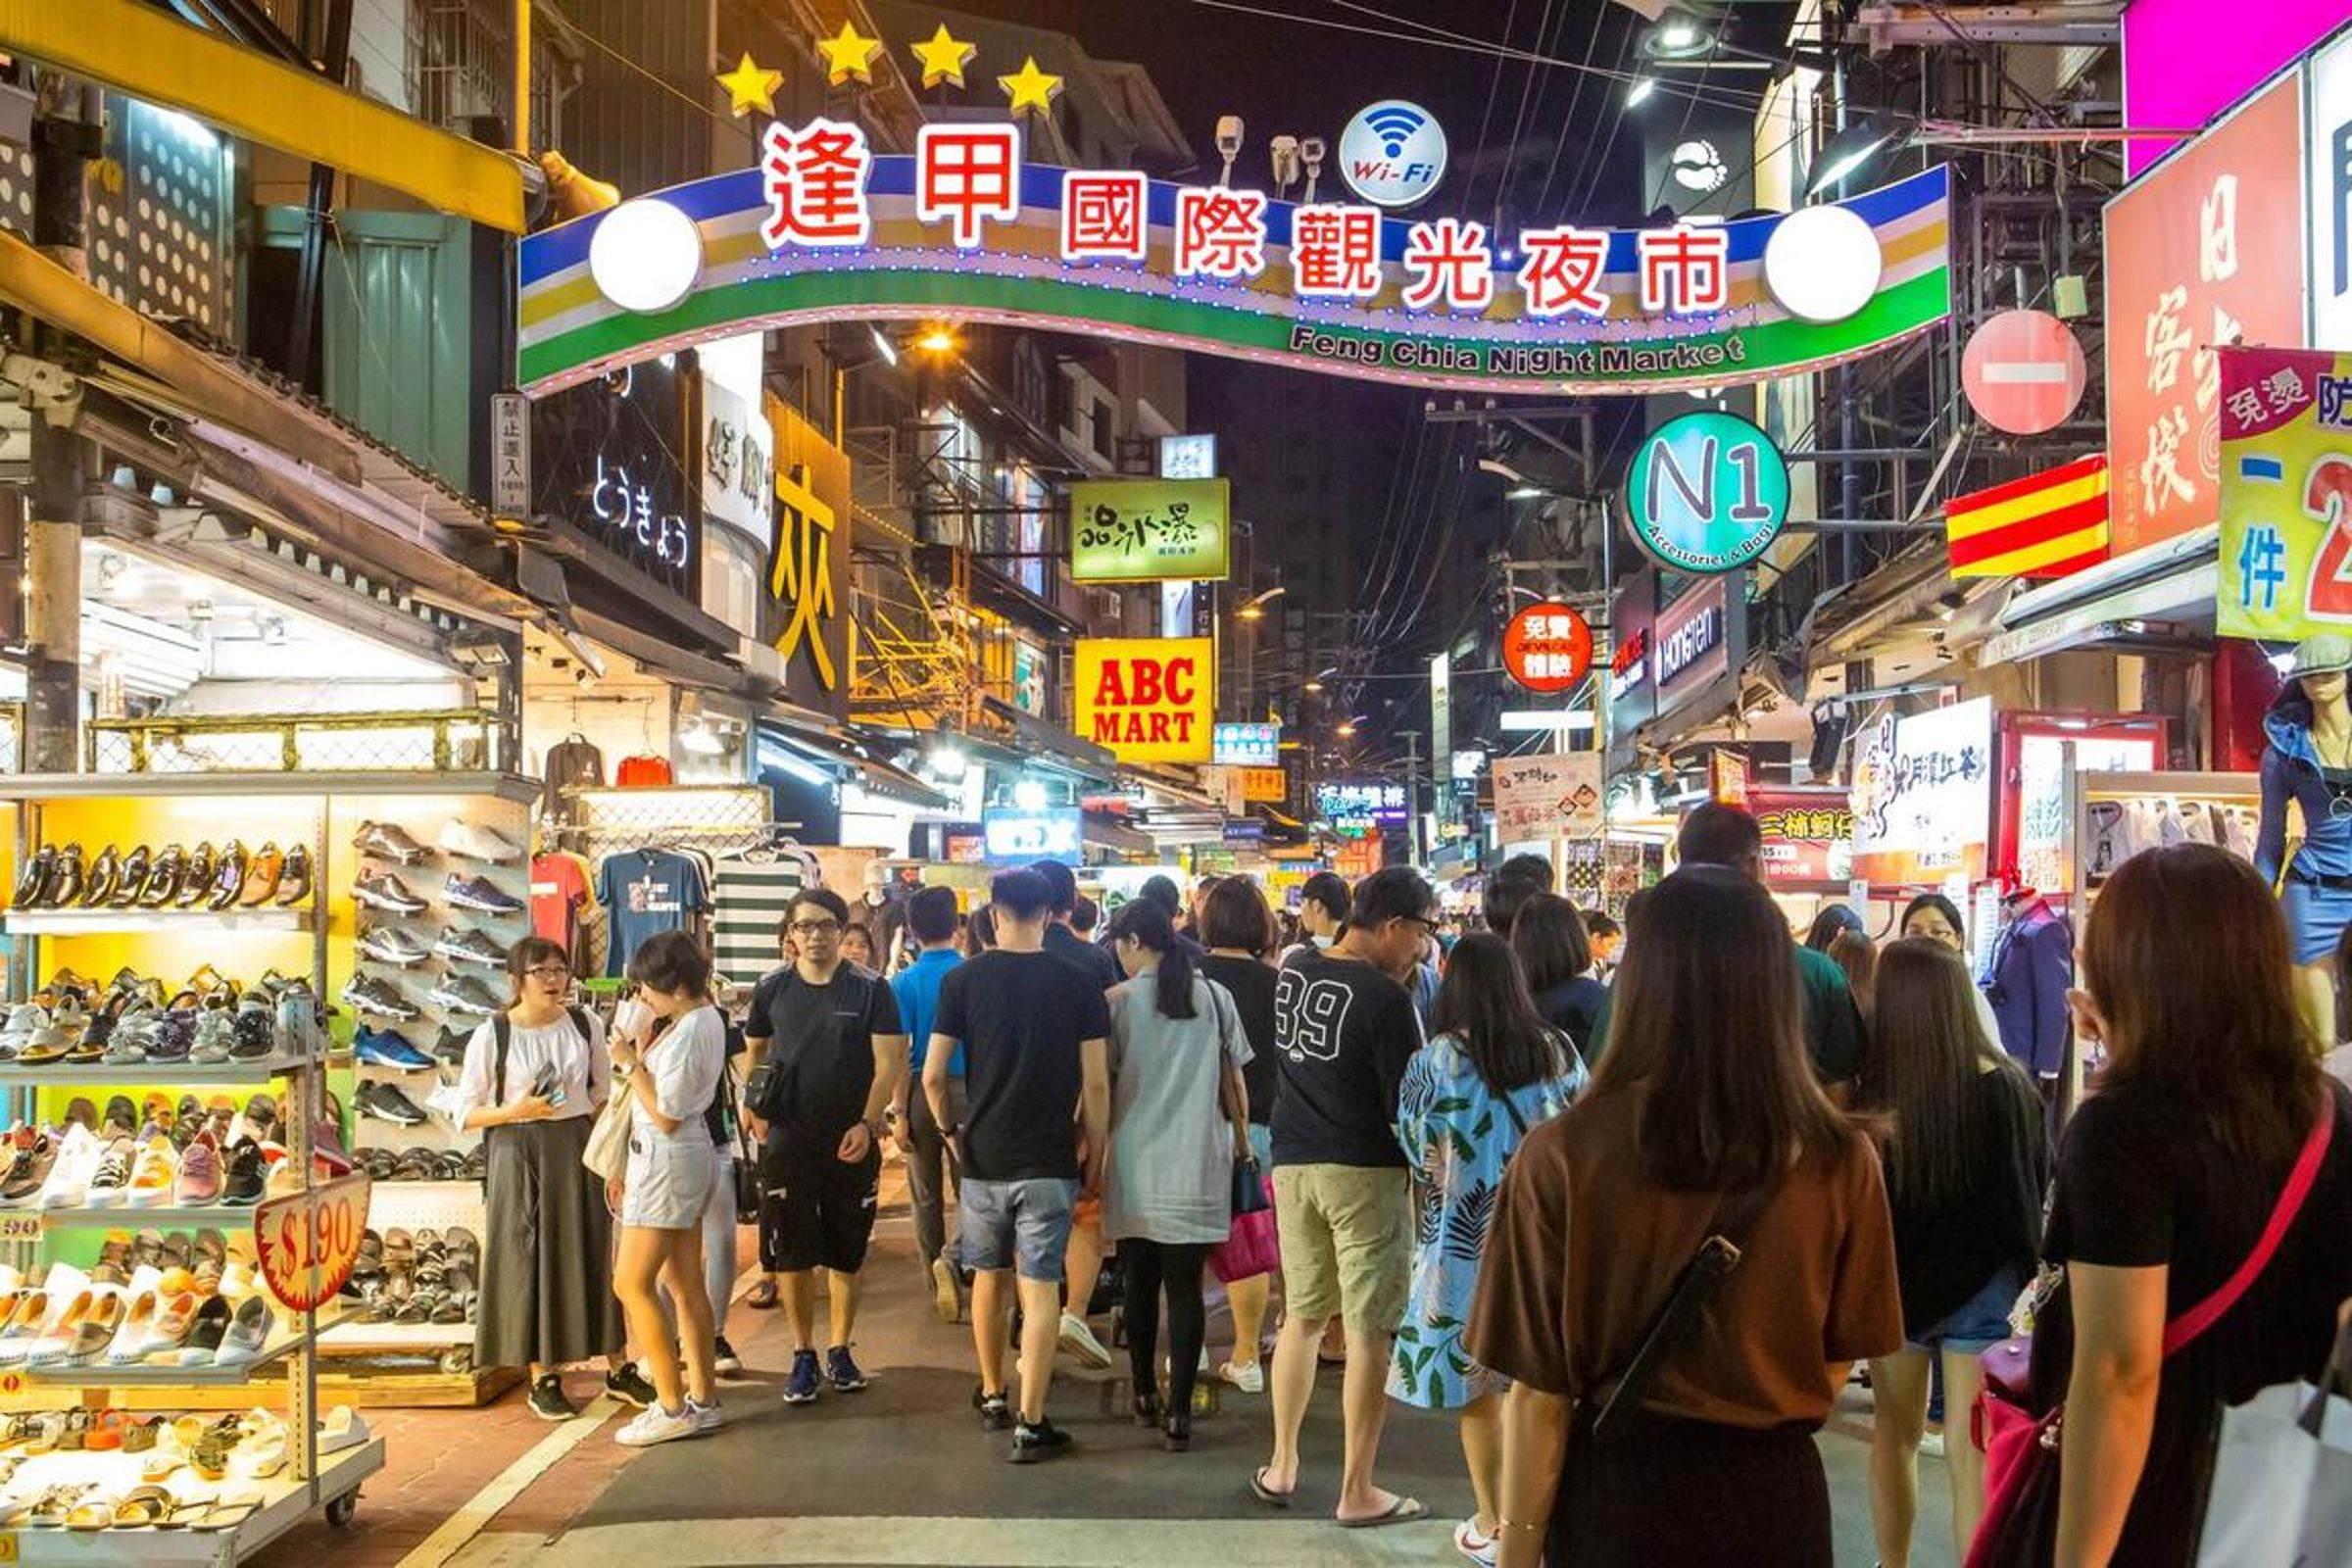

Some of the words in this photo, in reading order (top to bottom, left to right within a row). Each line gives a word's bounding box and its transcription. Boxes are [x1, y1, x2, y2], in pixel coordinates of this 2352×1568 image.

[1353, 161, 1434, 183] Wi-Fi
[764, 122, 1729, 314] 逢甲國際觀光夜市
[1291, 324, 1385, 364] Feng
[1391, 339, 1480, 370] Chia
[1488, 347, 1594, 373] Night
[1599, 336, 1745, 372] Market
[1647, 437, 1772, 522] N1
[1646, 525, 1726, 565] Accessories
[1094, 658, 1195, 706] ABC
[1094, 711, 1196, 743] MART
